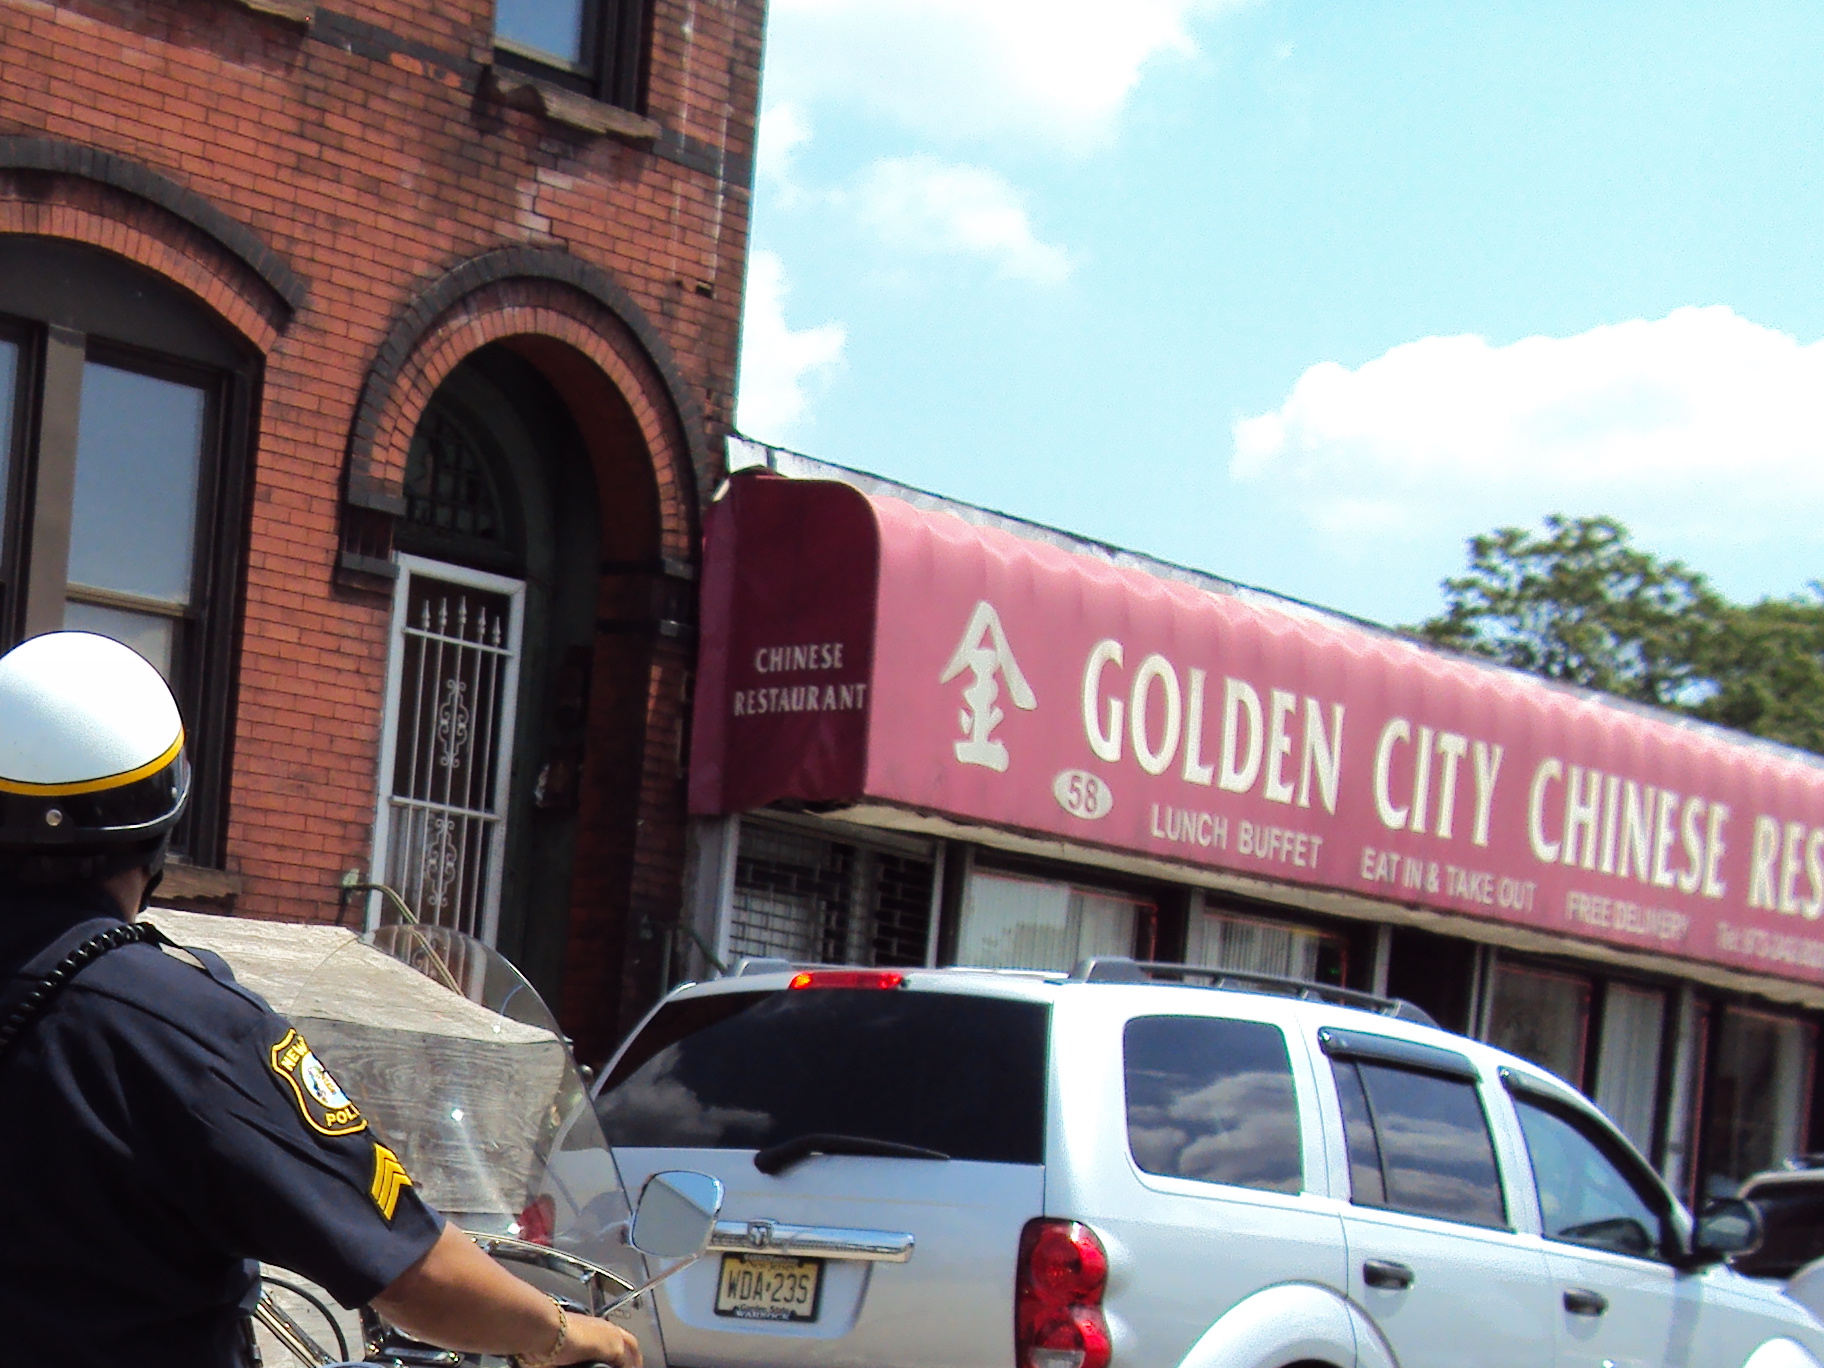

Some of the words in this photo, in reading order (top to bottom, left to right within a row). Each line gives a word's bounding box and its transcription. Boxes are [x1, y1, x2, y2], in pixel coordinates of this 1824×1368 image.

[755, 643, 844, 673] CHINESE
[734, 684, 866, 716] RESTAURANT
[1068, 774, 1098, 814] 58
[1082, 639, 1345, 815] GOLDEN
[1373, 717, 1504, 847] CITY
[1528, 757, 1731, 899] CHINESE
[1747, 815, 1824, 921] RES
[1150, 804, 1228, 850] LUNCH
[1238, 821, 1323, 868] BUFFET
[1360, 847, 1400, 883] EAT
[1402, 857, 1423, 889] IN
[1427, 862, 1439, 893] &
[1446, 865, 1494, 905] TAKE
[1498, 877, 1536, 913] OUT
[1566, 890, 1610, 927] FREE
[1613, 899, 1689, 941] DELIVERY
